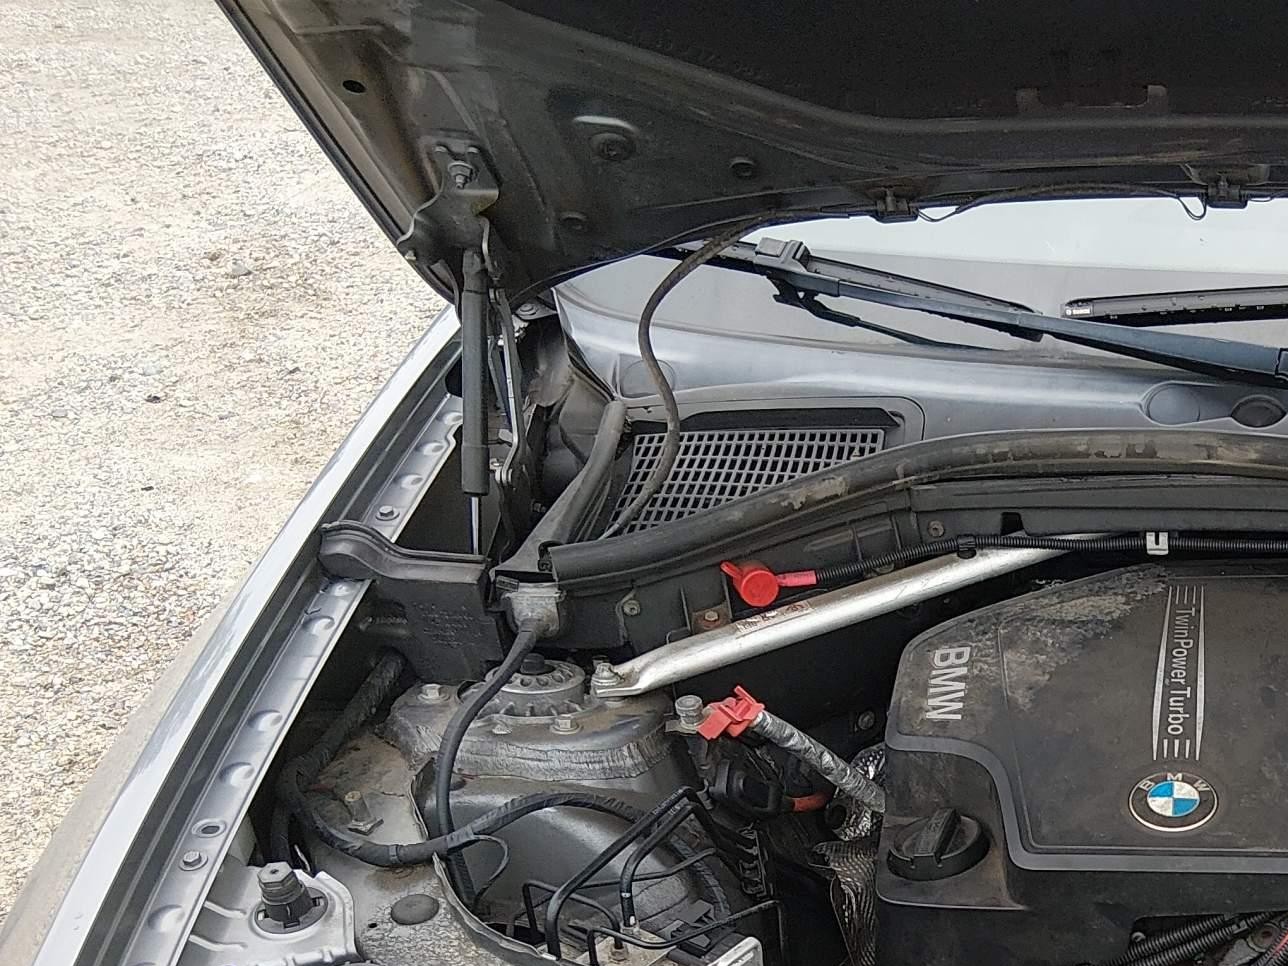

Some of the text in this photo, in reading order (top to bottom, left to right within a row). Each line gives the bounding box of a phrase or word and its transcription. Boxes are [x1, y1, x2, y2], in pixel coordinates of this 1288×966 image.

[925, 646, 972, 720] BMW
[1167, 607, 1196, 735] TwinPower Turbo
[1138, 772, 1211, 795] BMW
